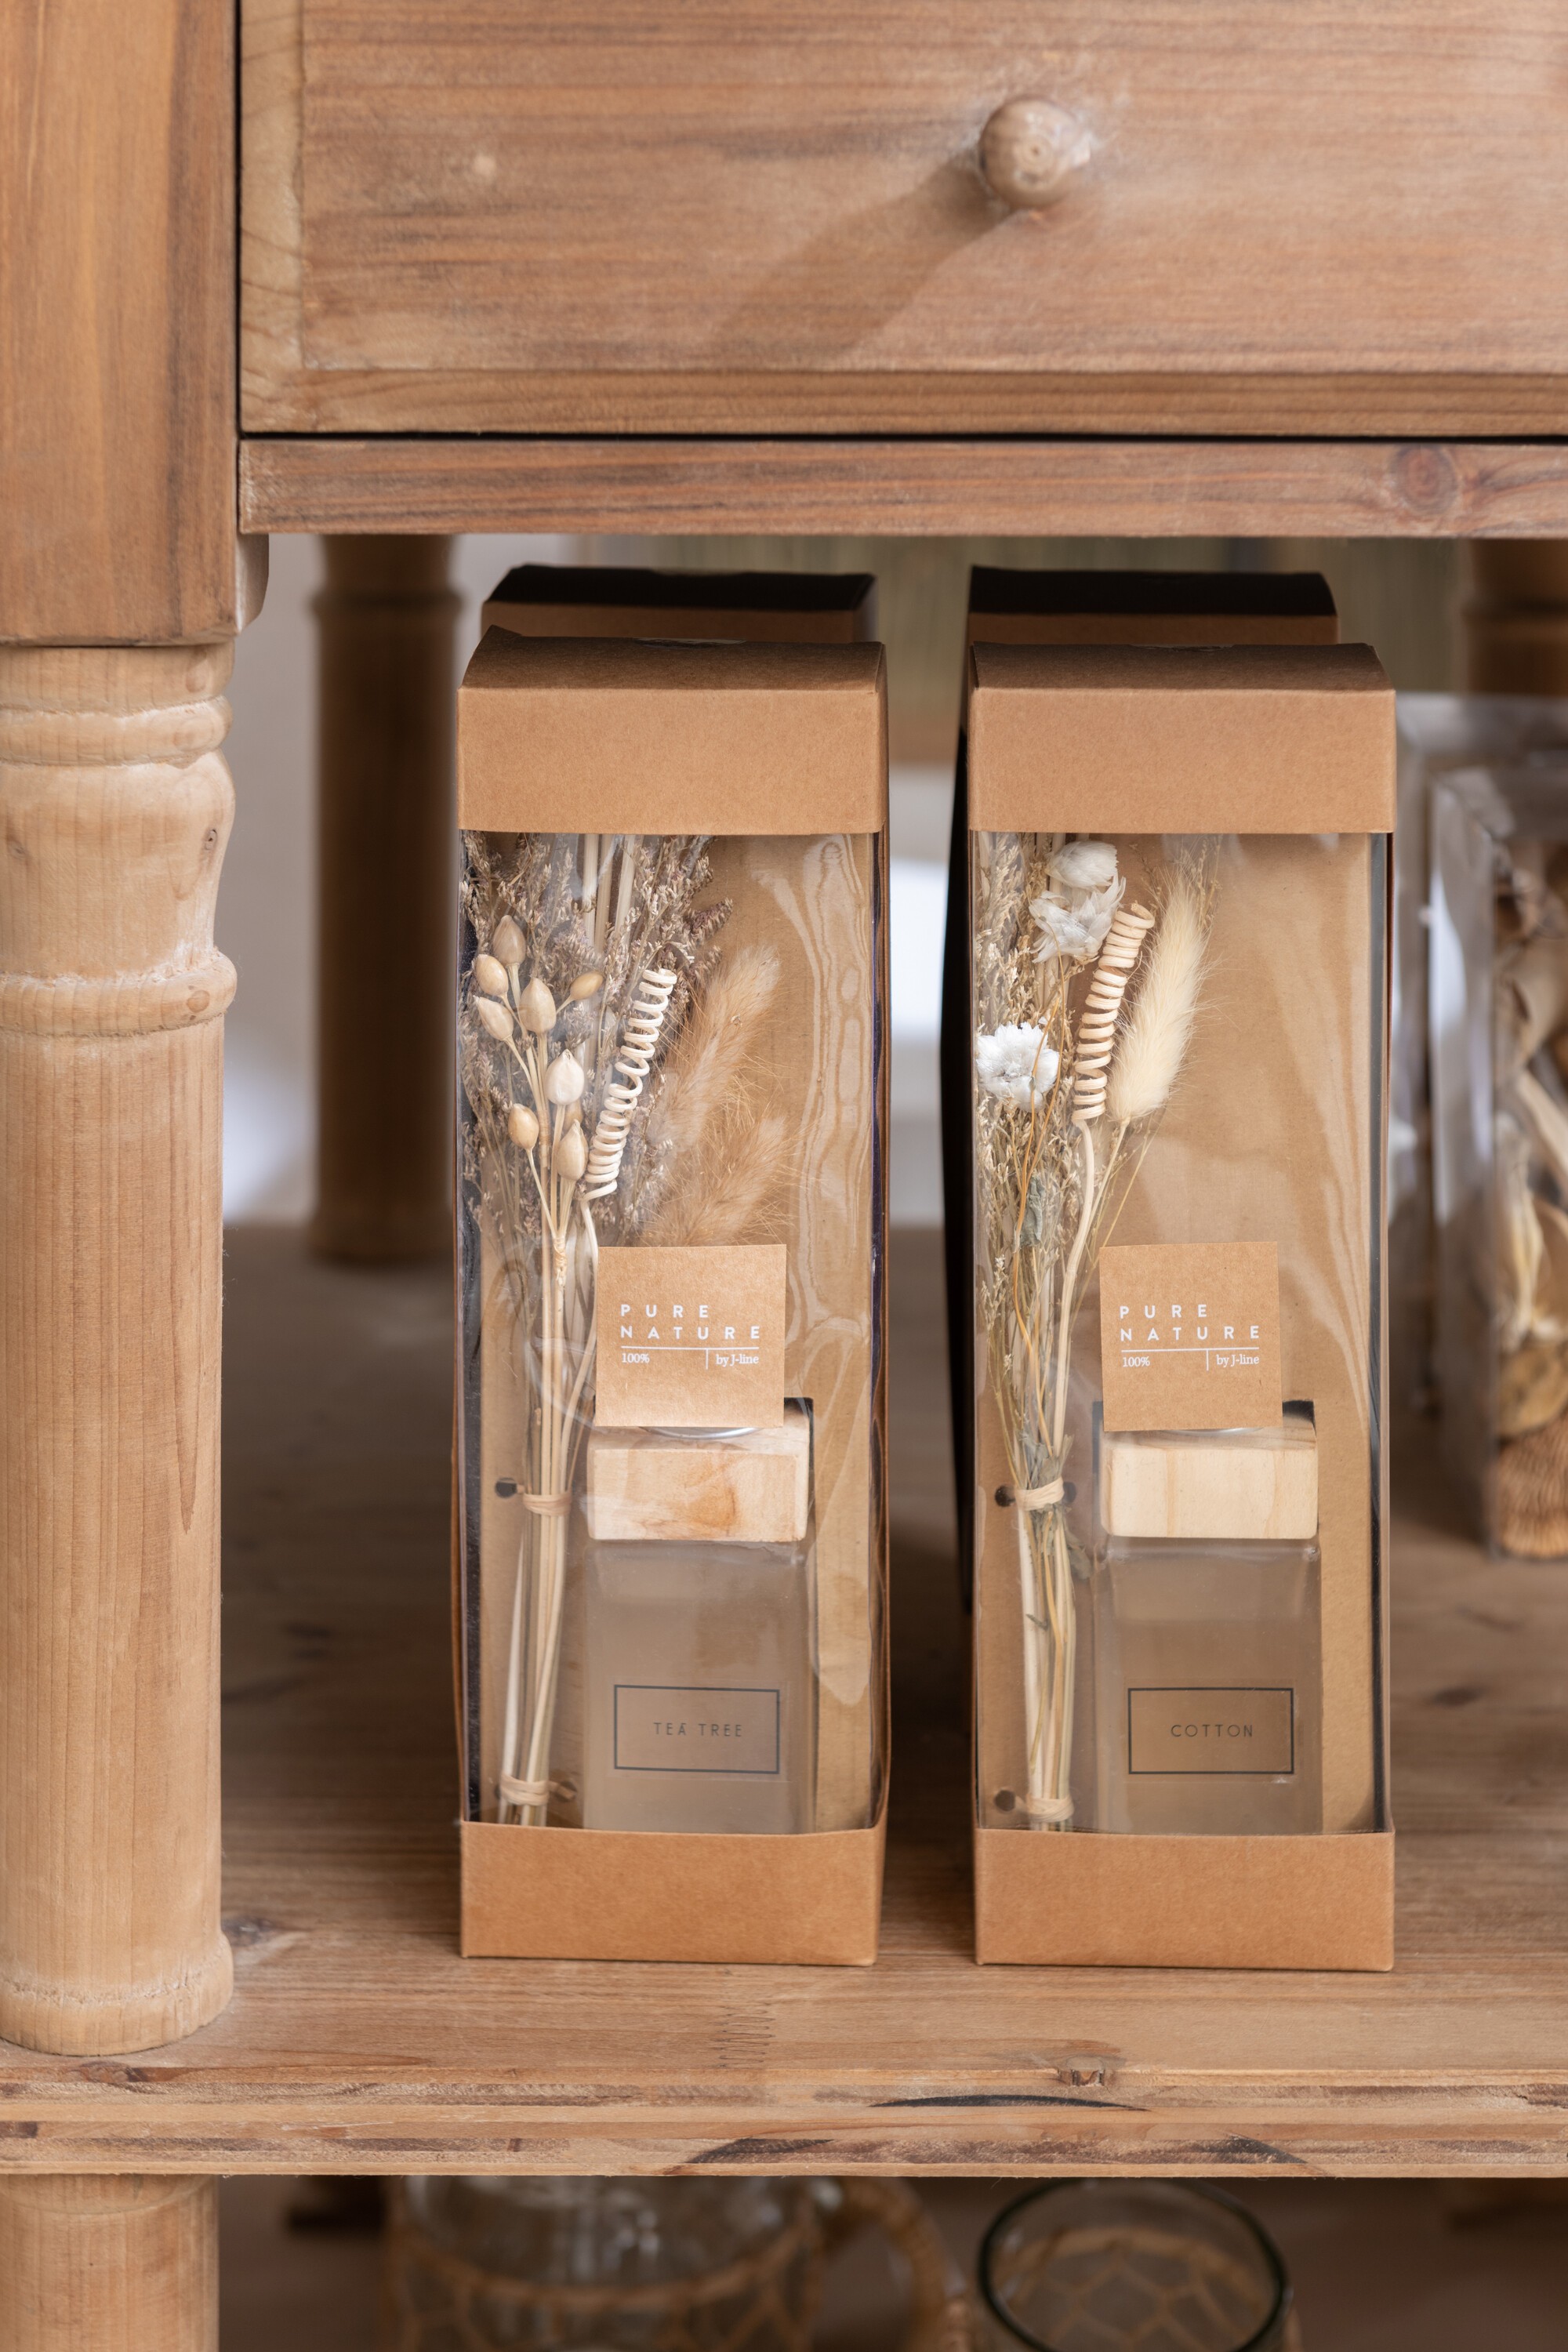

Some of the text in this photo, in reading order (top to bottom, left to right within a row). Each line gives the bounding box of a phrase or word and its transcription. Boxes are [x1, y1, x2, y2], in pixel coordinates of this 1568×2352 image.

[620, 1304, 709, 1318] PURE
[1120, 1304, 1207, 1319] PURE
[620, 1325, 760, 1340] NATURE
[1120, 1325, 1260, 1341] NATURE
[621, 1352, 650, 1363] 100%
[715, 1354, 759, 1367] by J-line
[1123, 1356, 1150, 1367] 100%
[1216, 1354, 1260, 1367] by J-line
[653, 1722, 742, 1737] TEA TREE
[1170, 1724, 1253, 1737] COTTON
